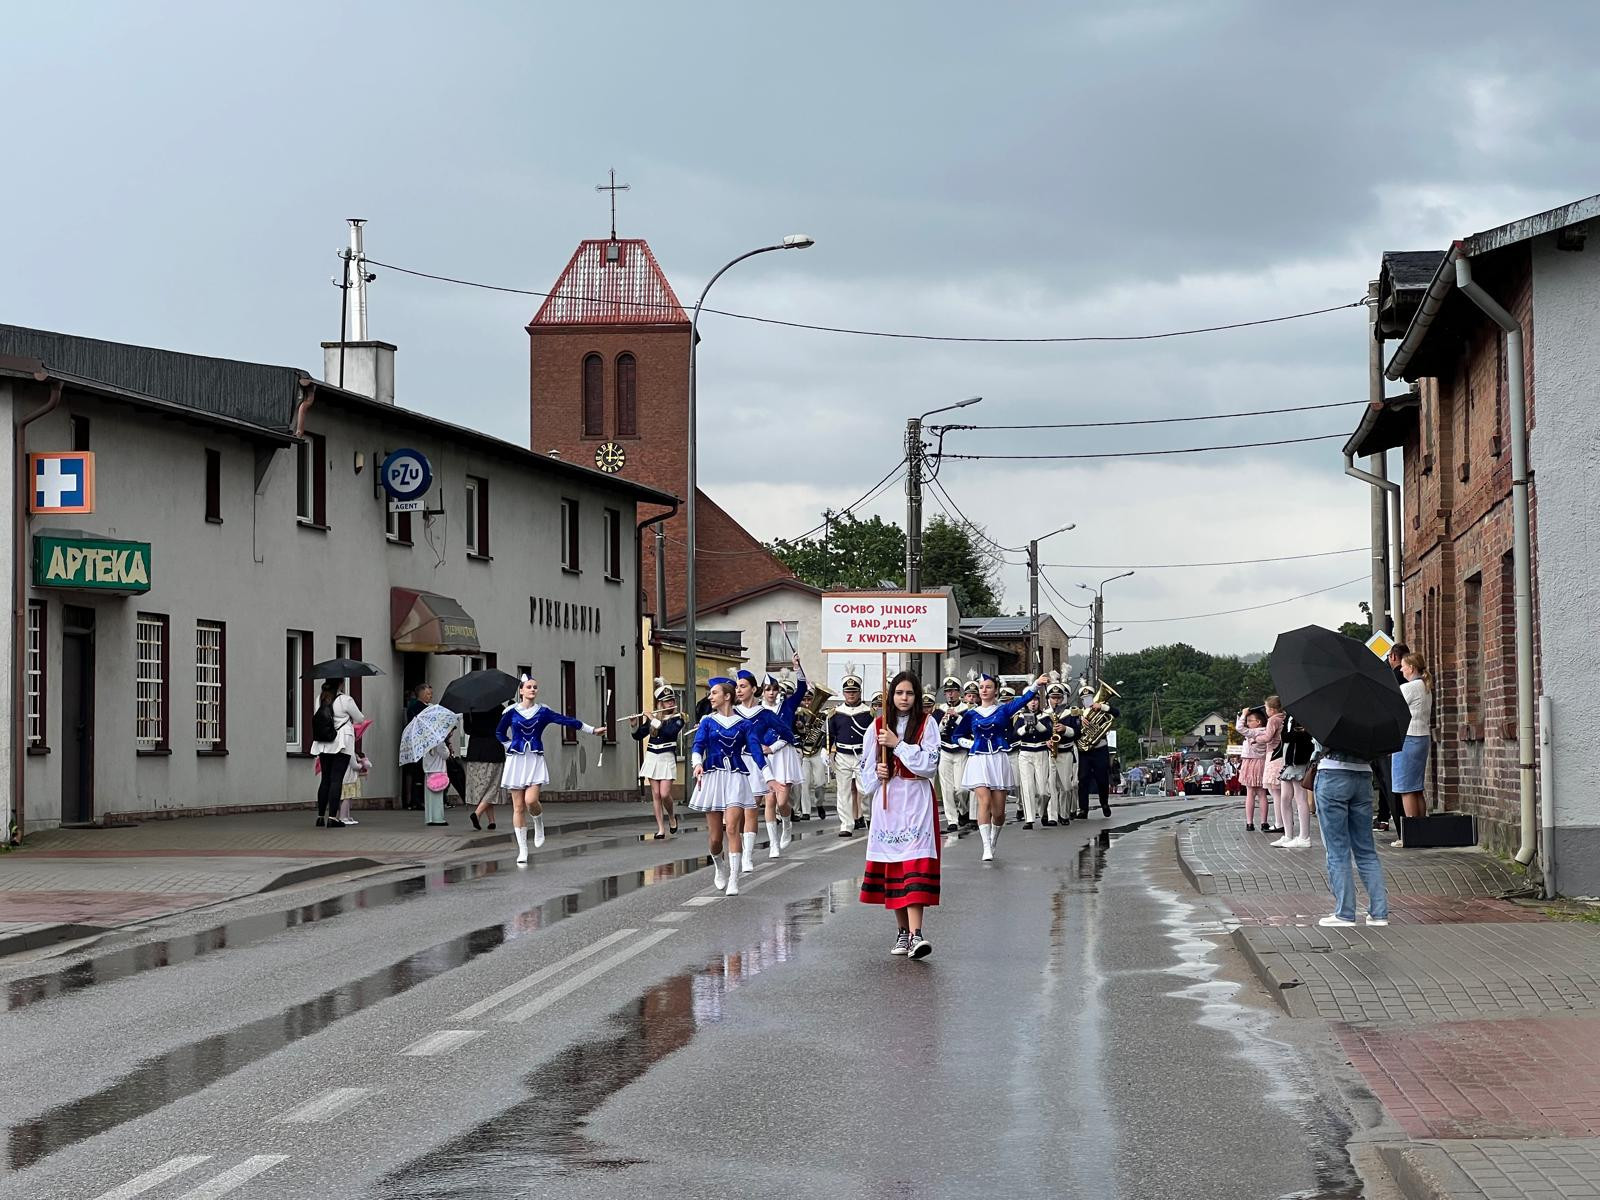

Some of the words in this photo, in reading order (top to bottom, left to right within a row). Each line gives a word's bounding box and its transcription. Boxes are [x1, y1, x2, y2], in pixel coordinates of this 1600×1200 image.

[391, 463, 419, 485] PZU
[46, 546, 148, 584] APTEKA
[530, 596, 600, 633] PIEKARNIA
[834, 604, 875, 614] COMBO
[880, 605, 928, 616] JUNIORS
[850, 619, 880, 628] BAND
[846, 634, 853, 643] Z
[859, 634, 917, 643] KWIDZYNA
